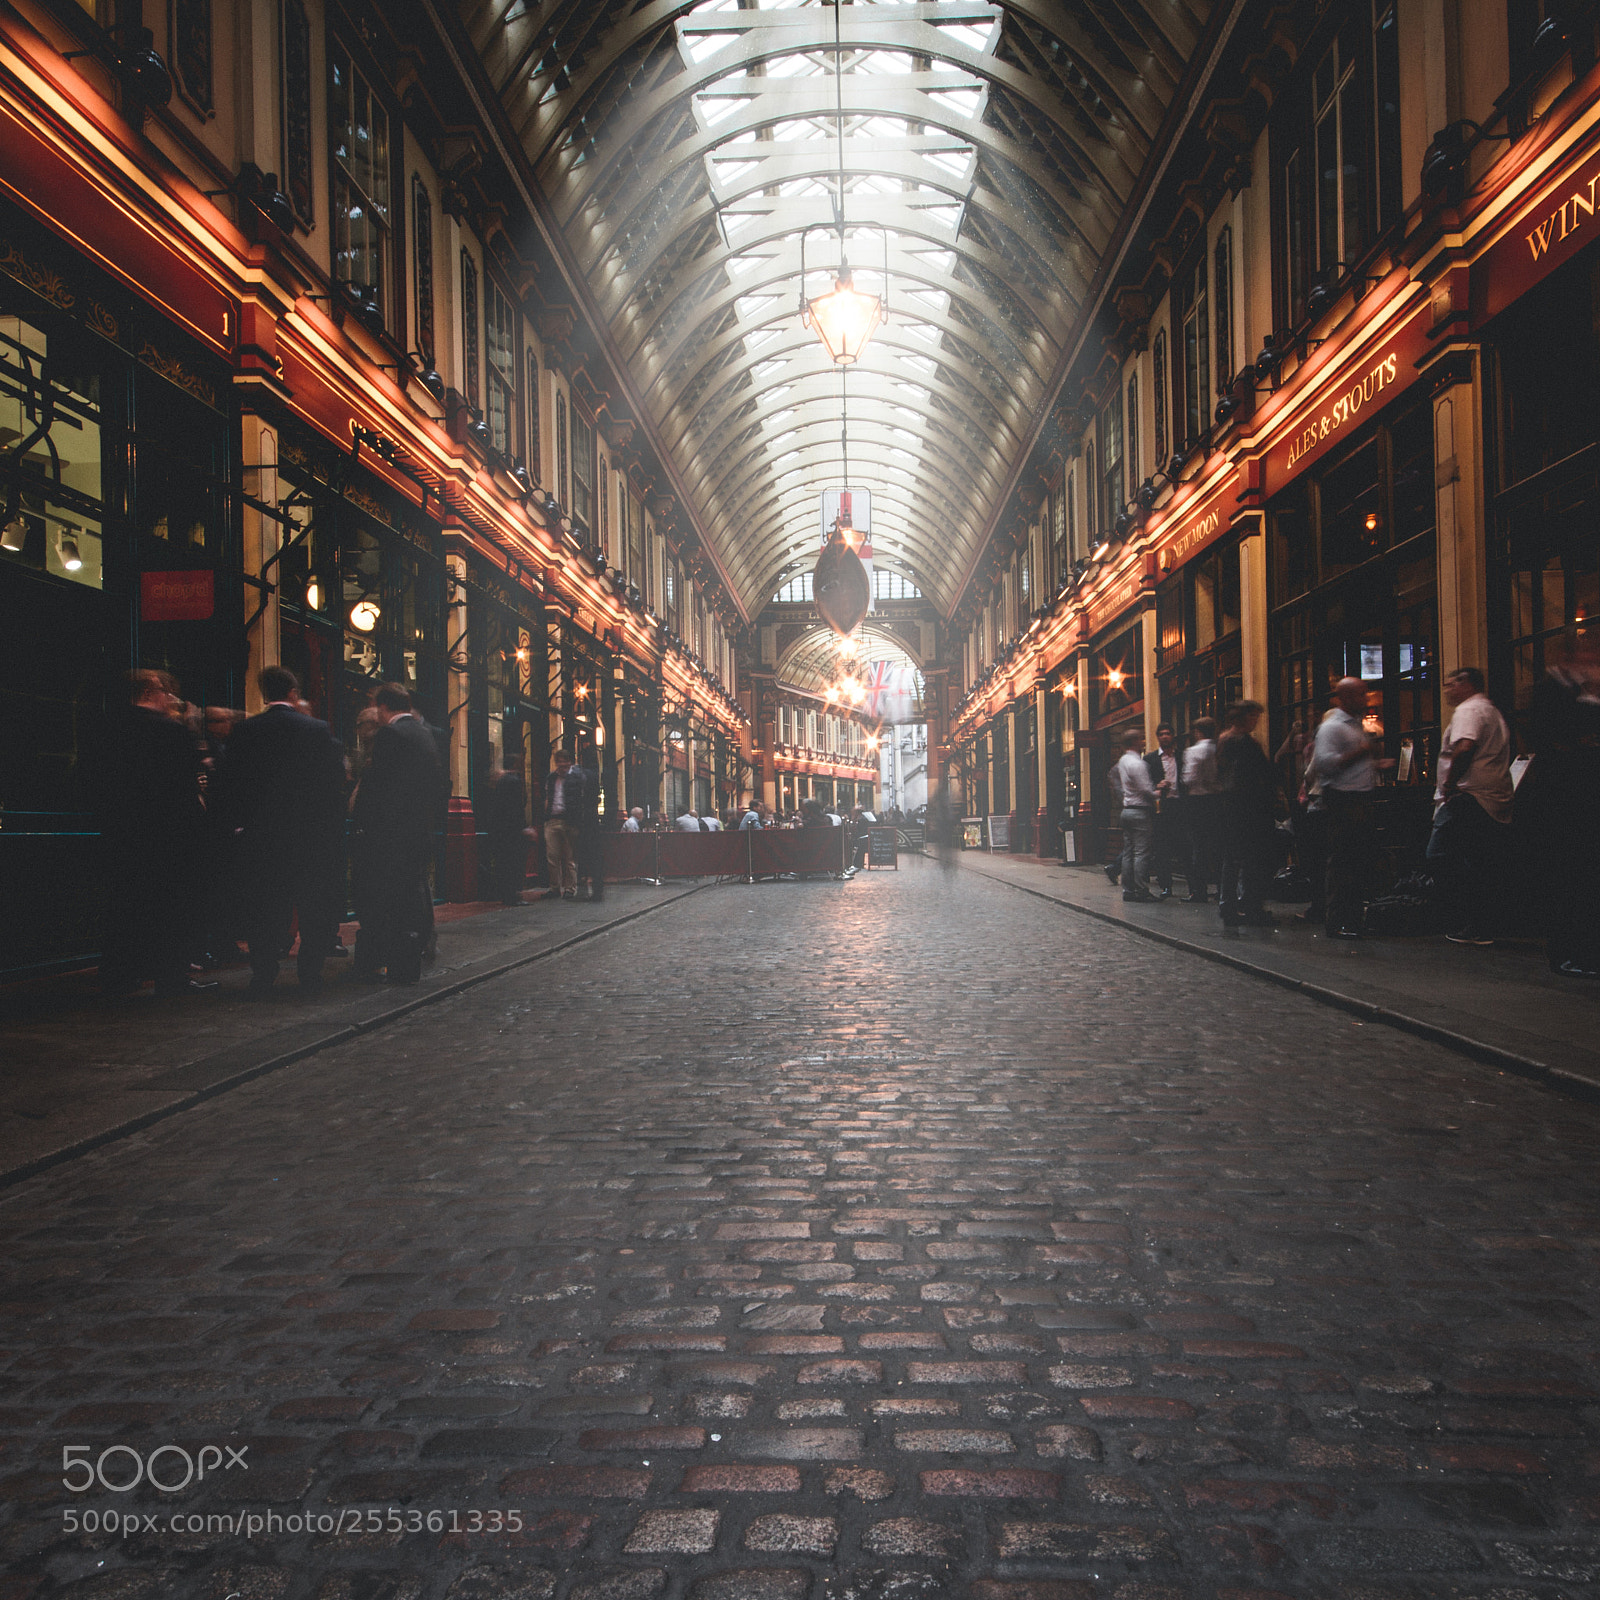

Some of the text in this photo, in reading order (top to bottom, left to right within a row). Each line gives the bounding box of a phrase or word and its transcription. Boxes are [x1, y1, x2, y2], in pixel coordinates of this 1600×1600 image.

[1525, 172, 1600, 262] WIN
[222, 312, 230, 337] 1
[275, 354, 284, 381] 2
[1286, 352, 1397, 470] ALES & STOUTS
[1173, 507, 1220, 558] NEW MOON
